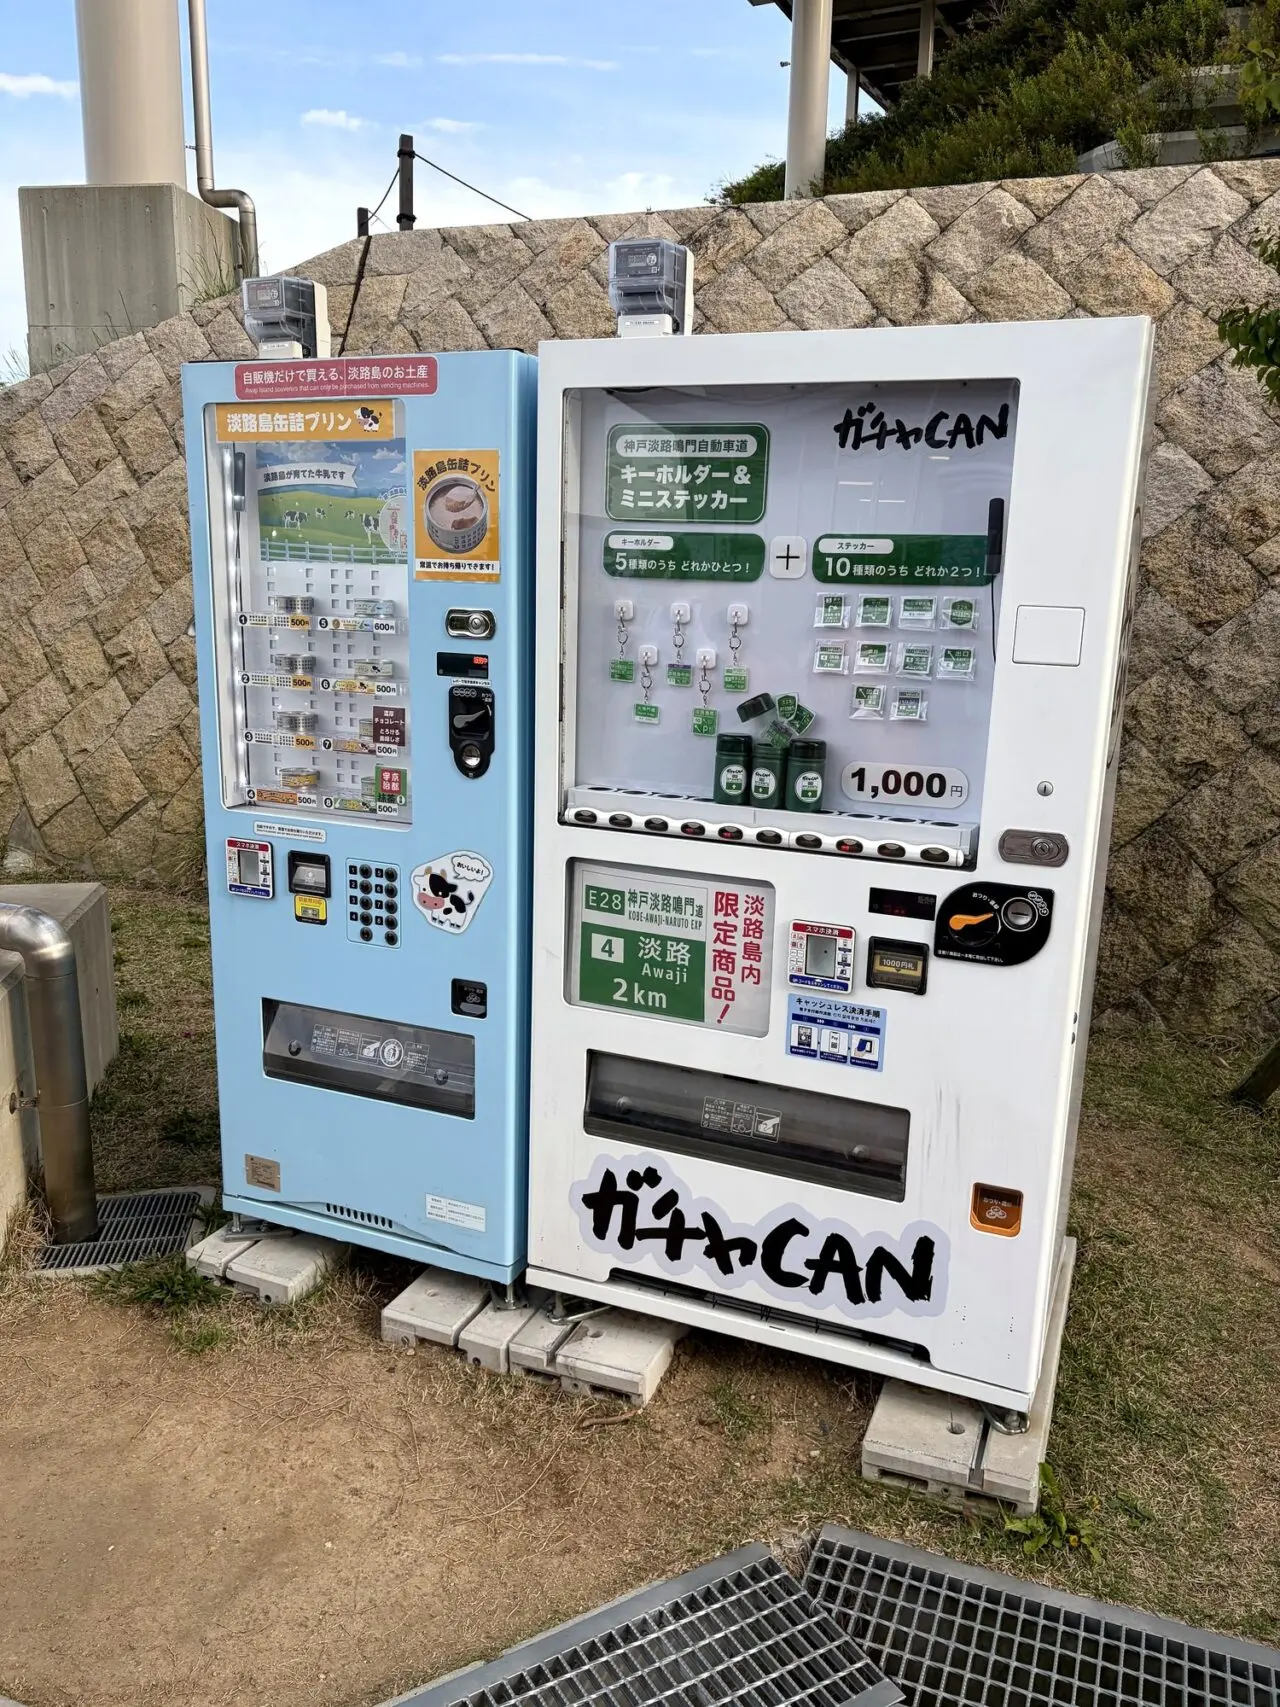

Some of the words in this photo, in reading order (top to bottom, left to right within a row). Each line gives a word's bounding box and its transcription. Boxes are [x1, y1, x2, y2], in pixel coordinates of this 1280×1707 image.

[243, 365, 429, 385] 自販機だけで買える、淡路島のお土産
[227, 412, 352, 433] 淡路島缶詰プリン
[833, 402, 1009, 452] ガチャCAN
[624, 439, 748, 453] 神戸淡路鳴門自動車道
[263, 468, 346, 483] 淡路島が育てた牛乳です
[417, 457, 495, 492] 淡路島缶詰プリン
[620, 489, 748, 510] ミニステッカー
[621, 538, 660, 547] キーホルダー
[837, 542, 874, 550] ステッカー
[374, 717, 405, 726] チョコレート
[588, 890, 622, 911] E28
[627, 888, 704, 918] 神戸淡路鳴門道
[628, 911, 689, 929] KOBE-AWAJI-NARUTO
[690, 918, 702, 930] EXP
[805, 925, 839, 936] スマホ決済
[600, 938, 614, 958] 4
[741, 894, 765, 986] 淡路島内
[638, 936, 692, 966] 淡路
[711, 891, 740, 1024] 限定商品!
[641, 963, 688, 985] Awaji
[795, 997, 881, 1019] キャッシュレス決済手順
[581, 1166, 935, 1305] ガチャCAN
